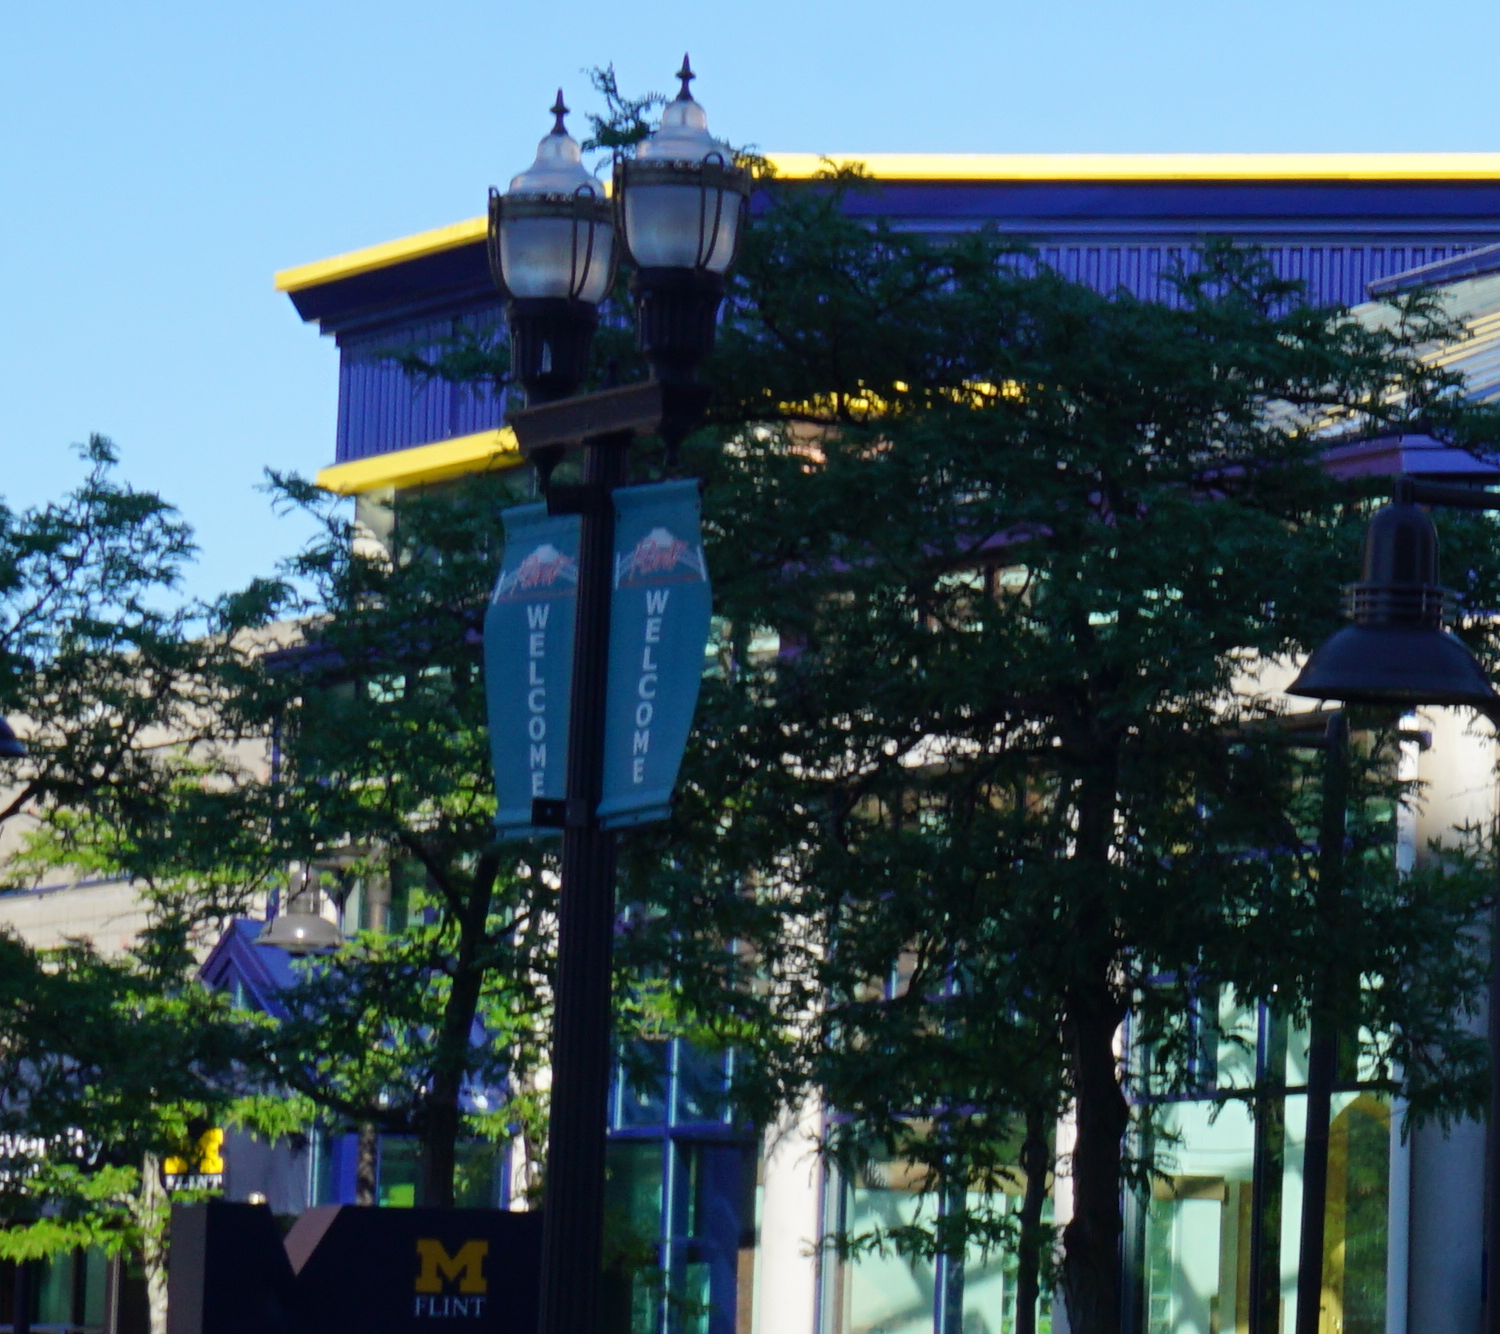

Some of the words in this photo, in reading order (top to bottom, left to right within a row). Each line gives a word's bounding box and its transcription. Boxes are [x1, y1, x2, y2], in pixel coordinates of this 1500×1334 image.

[527, 604, 550, 797] WELCOME
[633, 589, 669, 784] WELCOME
[414, 1238, 489, 1293] M
[414, 1295, 486, 1317] FLINT
